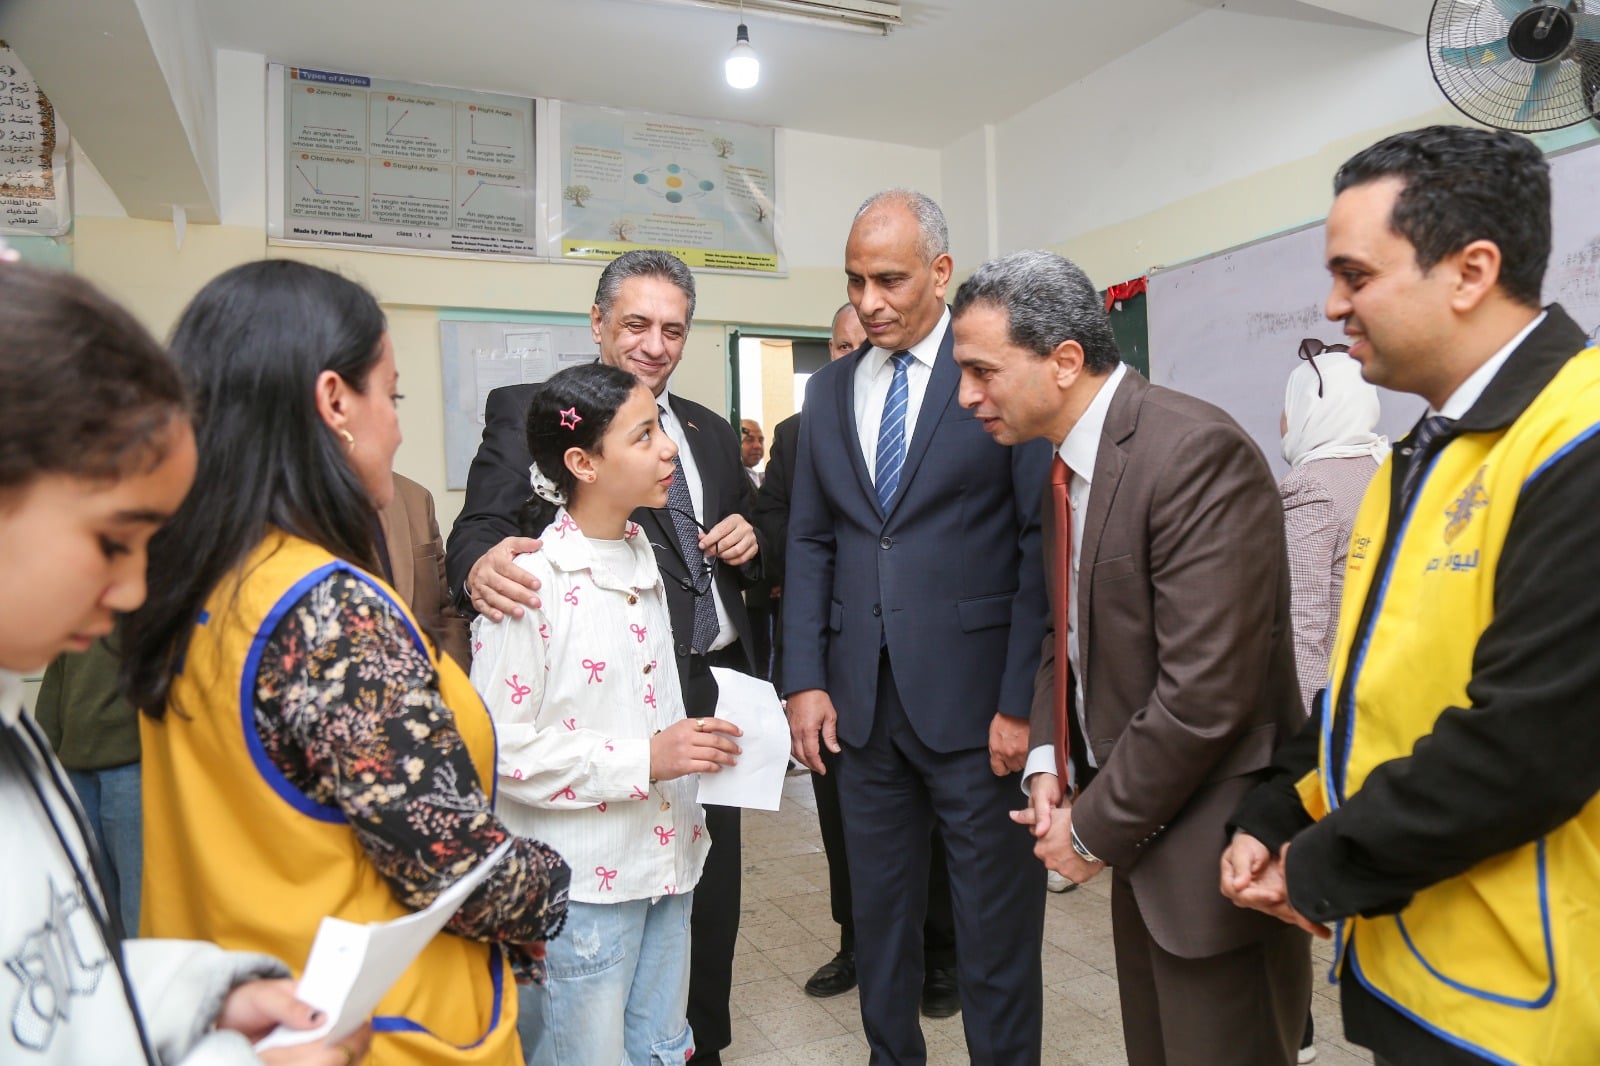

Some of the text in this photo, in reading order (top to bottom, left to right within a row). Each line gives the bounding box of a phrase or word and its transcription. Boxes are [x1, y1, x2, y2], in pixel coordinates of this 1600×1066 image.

[302, 72, 326, 81] Types
[339, 76, 367, 85] Angles
[310, 154, 335, 162] Obtuse
[392, 162, 418, 170] Straight
[497, 173, 516, 181] Angle
[26, 199, 43, 207] عمل
[23, 207, 38, 215] أحمد
[310, 228, 319, 236] by
